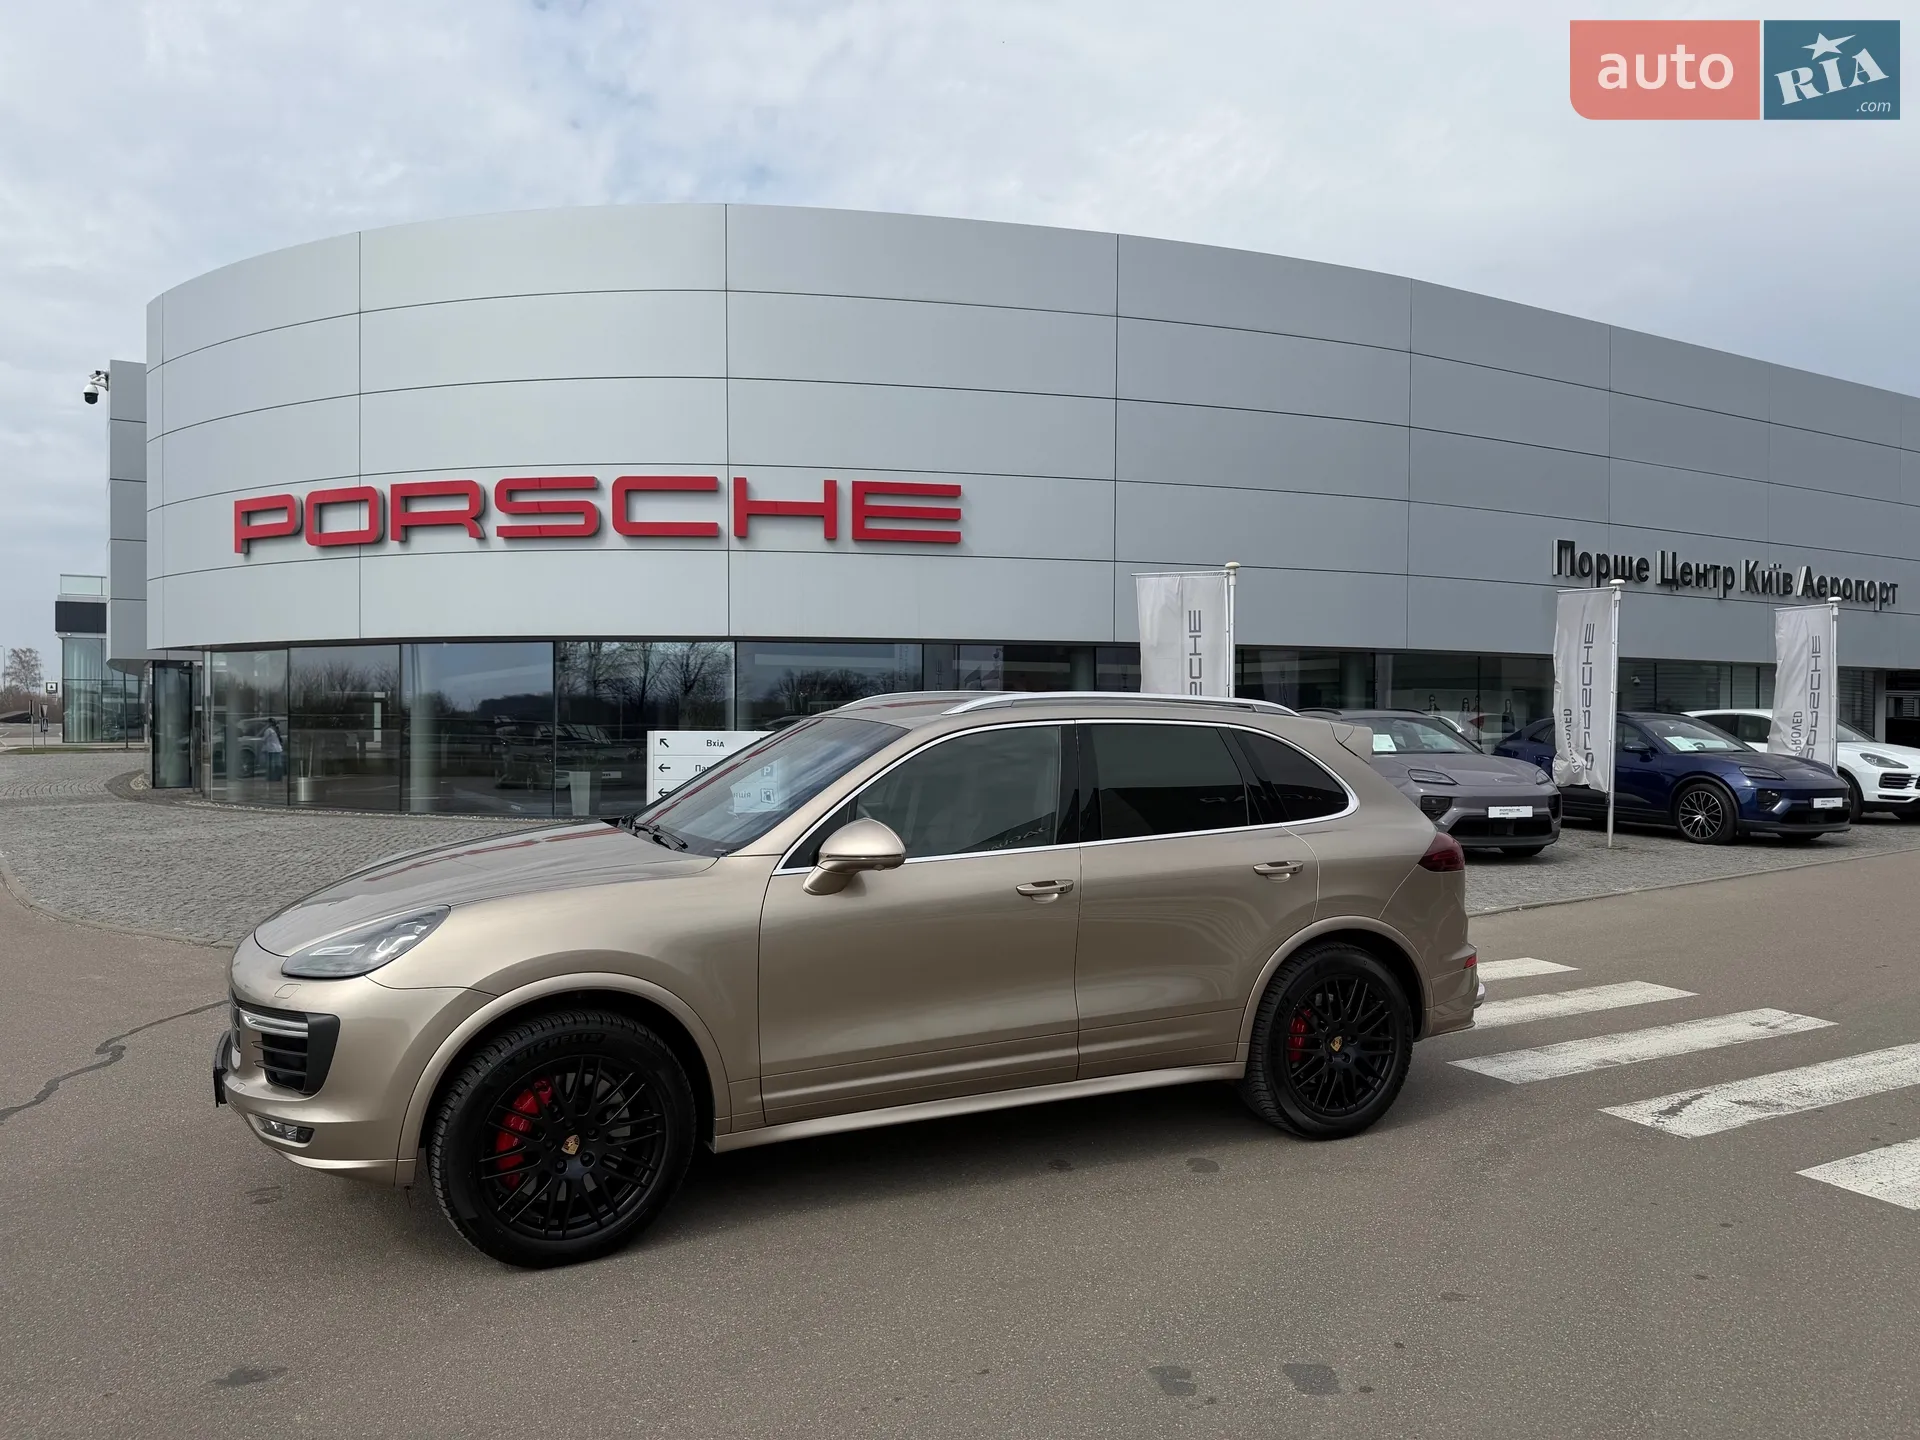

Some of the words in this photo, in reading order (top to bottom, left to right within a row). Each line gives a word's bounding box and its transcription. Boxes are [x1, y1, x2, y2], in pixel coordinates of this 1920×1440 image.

[233, 475, 962, 555] PORSCHE
[1552, 539, 1650, 588] Порше
[1656, 550, 1735, 599] Центр
[1740, 559, 1794, 596] Київ
[1795, 565, 1899, 611] Аеропорт
[706, 739, 725, 748] Вхід
